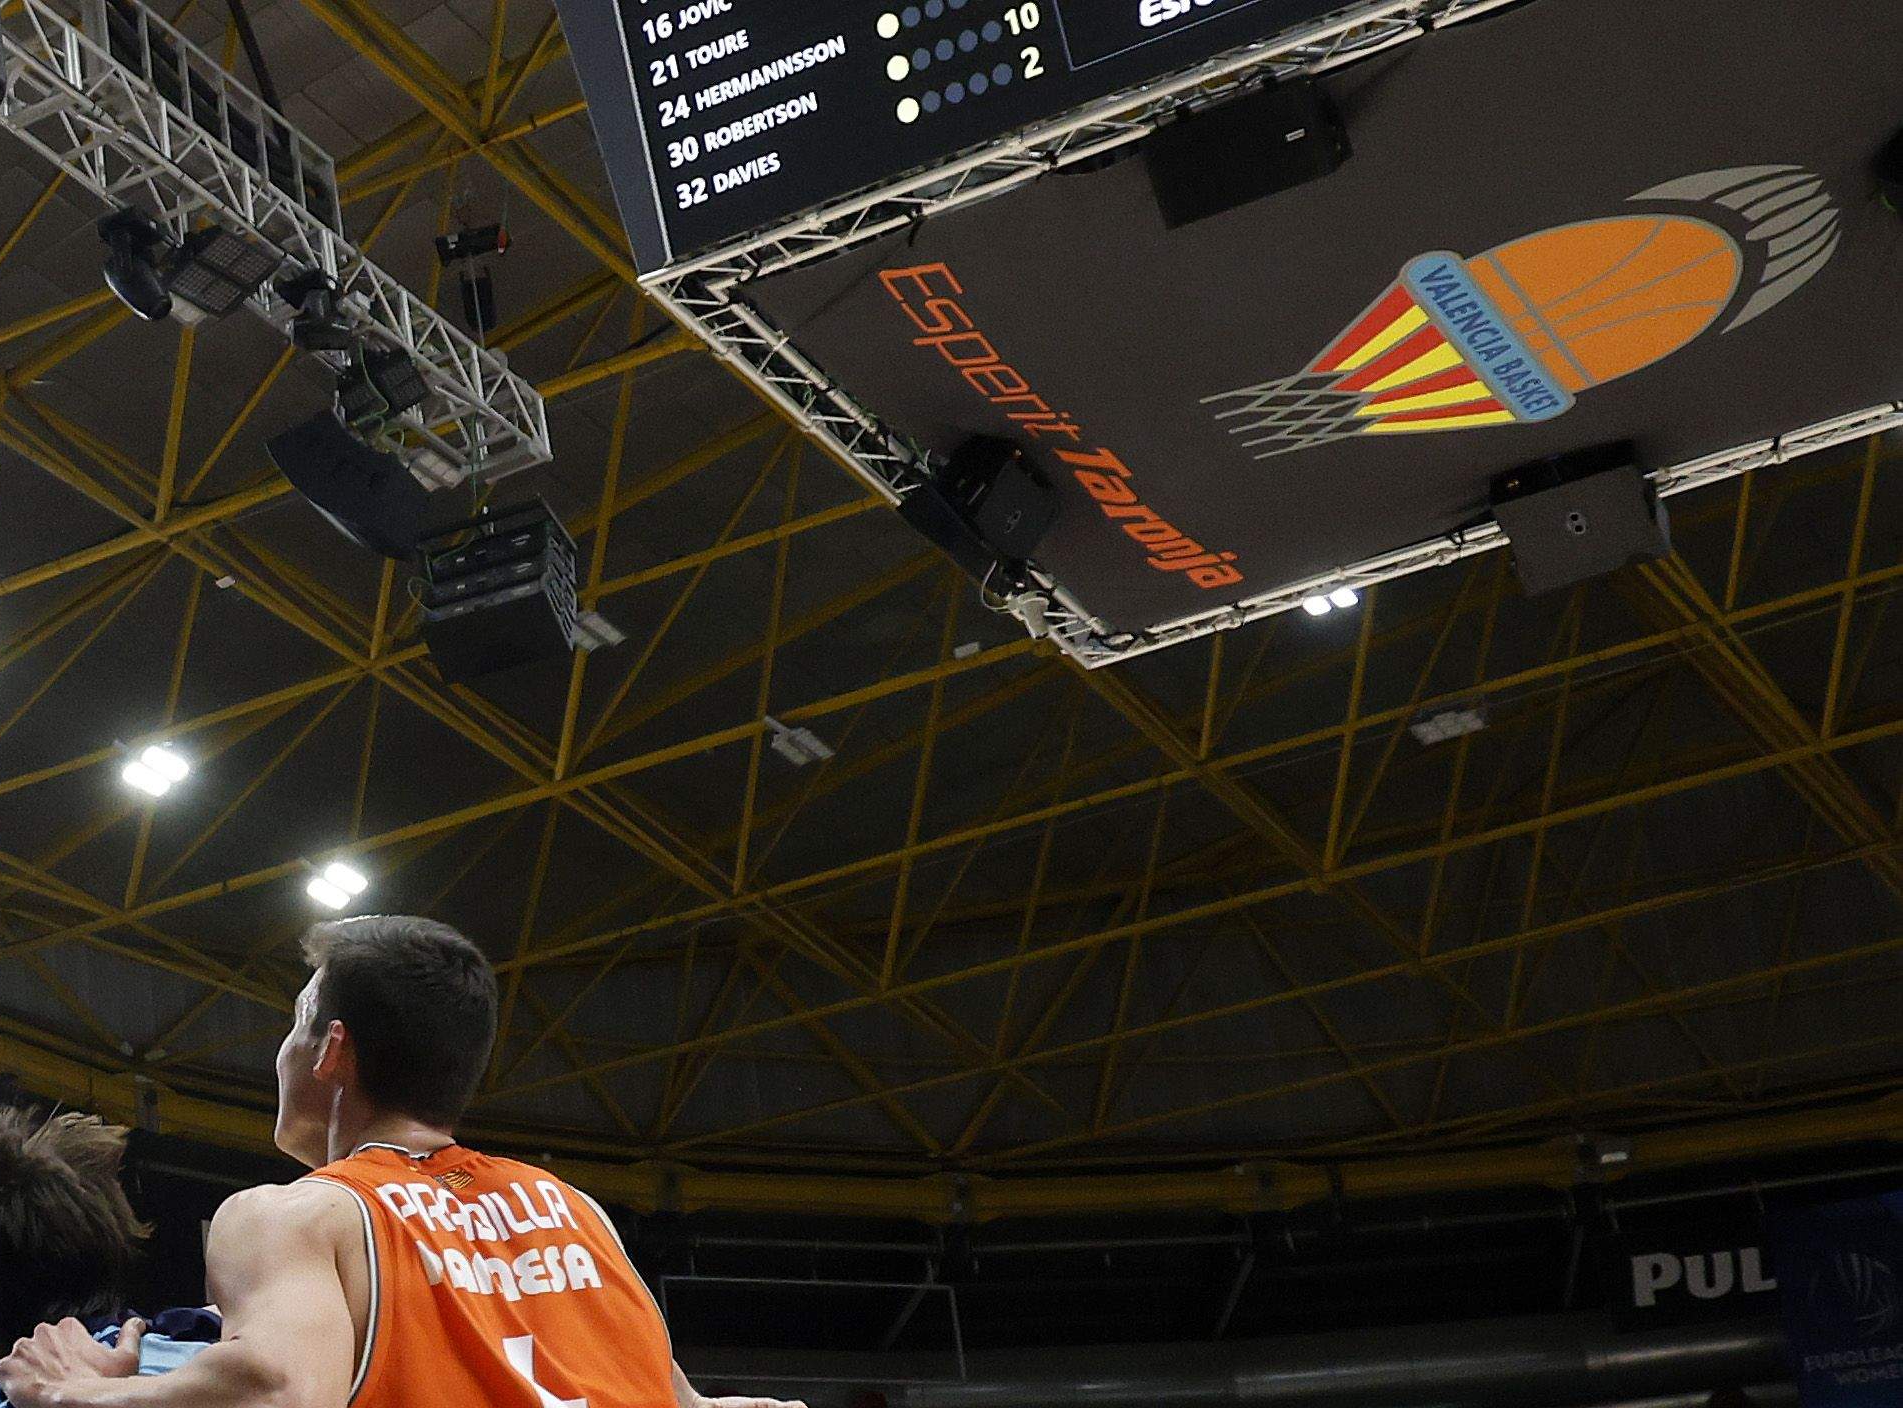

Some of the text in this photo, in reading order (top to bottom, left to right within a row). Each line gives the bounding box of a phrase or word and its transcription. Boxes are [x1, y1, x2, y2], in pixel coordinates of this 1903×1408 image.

[642, 13, 673, 45] 16
[649, 28, 750, 87] 21 TOURE
[658, 35, 846, 128] 24 HERMANNSSON
[667, 2, 1040, 169] 30 ROBERTSON 10
[676, 45, 1045, 210] 32 DAVIES 2
[1419, 263, 1562, 415] VALENCIA BASKET
[878, 261, 1245, 590] Esperit Taronja
